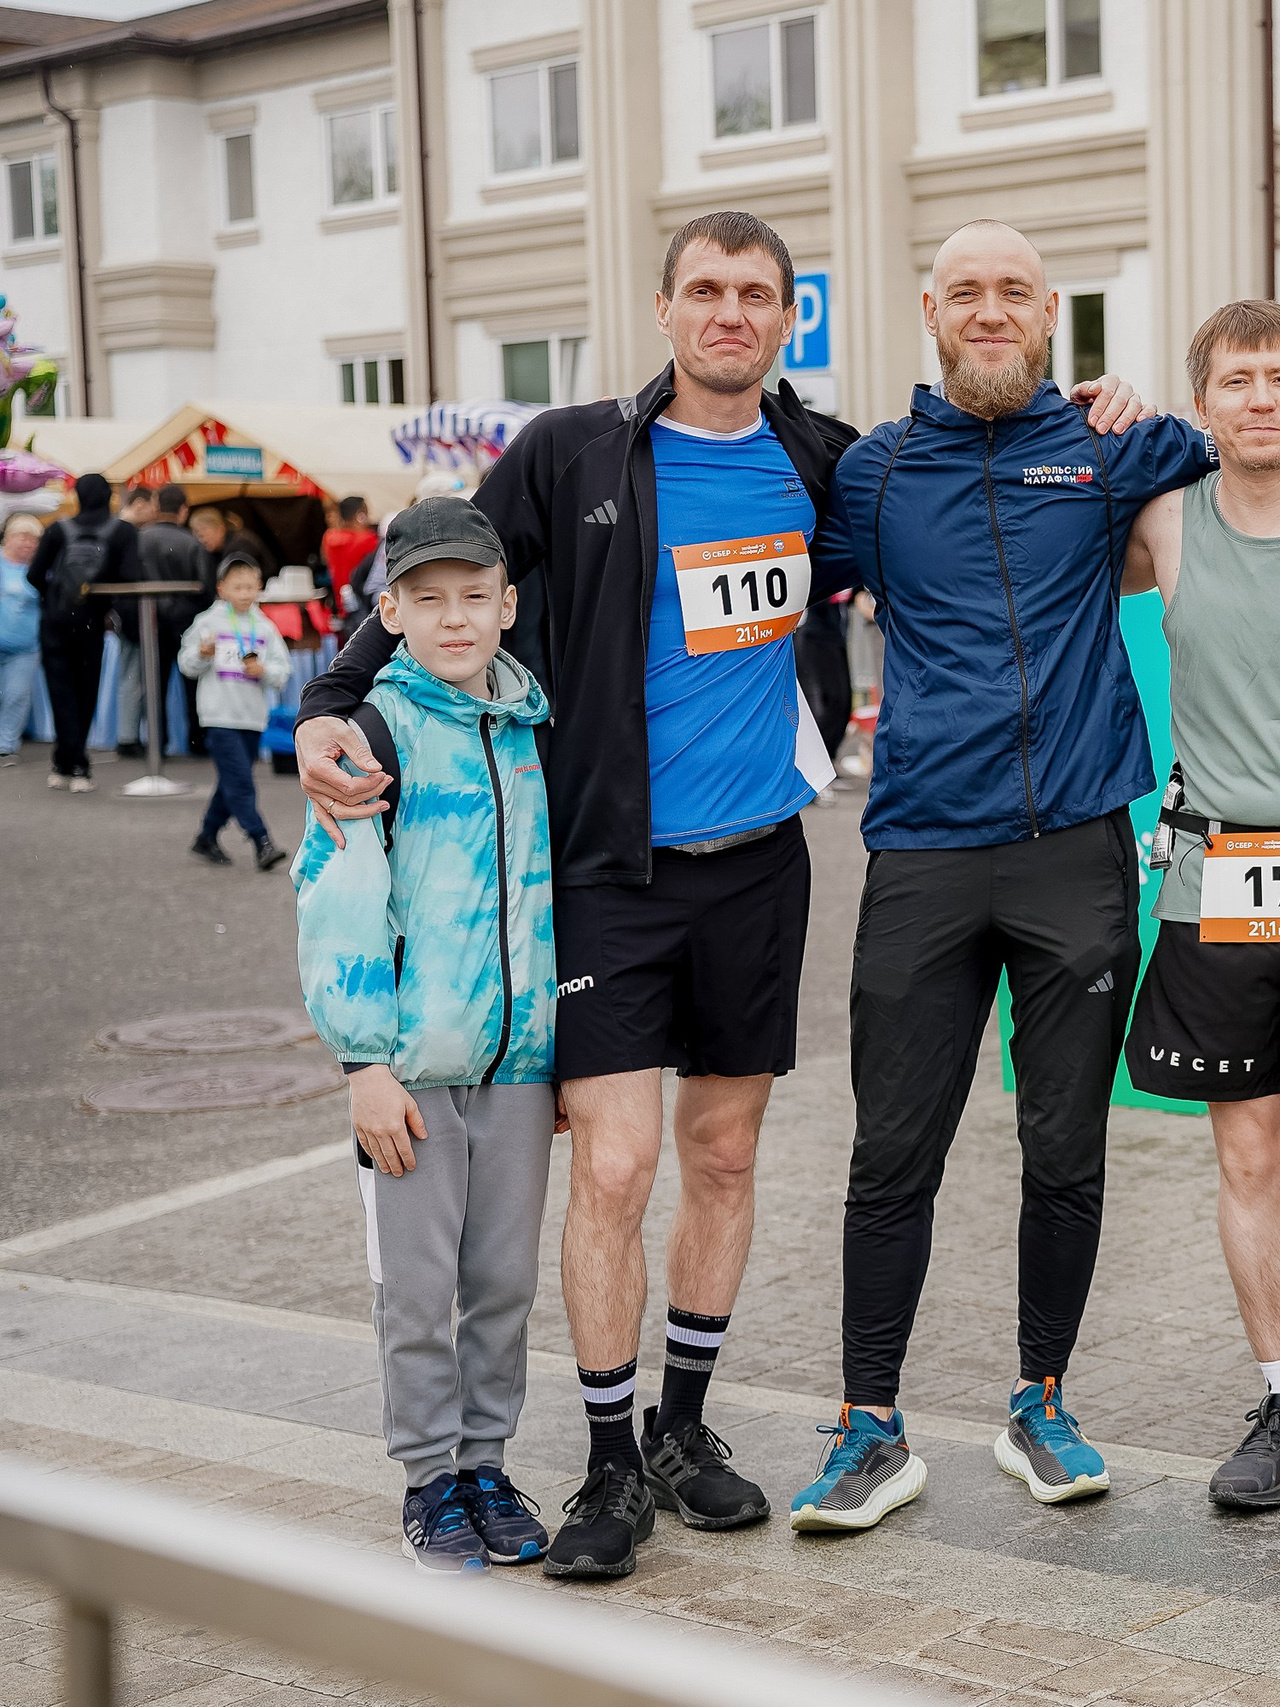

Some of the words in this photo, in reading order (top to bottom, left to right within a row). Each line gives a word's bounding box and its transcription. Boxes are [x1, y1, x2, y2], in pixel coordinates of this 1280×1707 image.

[793, 282, 824, 363] P
[1023, 475, 1077, 485] МАРАФОН
[712, 549, 731, 558] СБЕР
[711, 567, 788, 616] 110
[557, 975, 594, 998] mon
